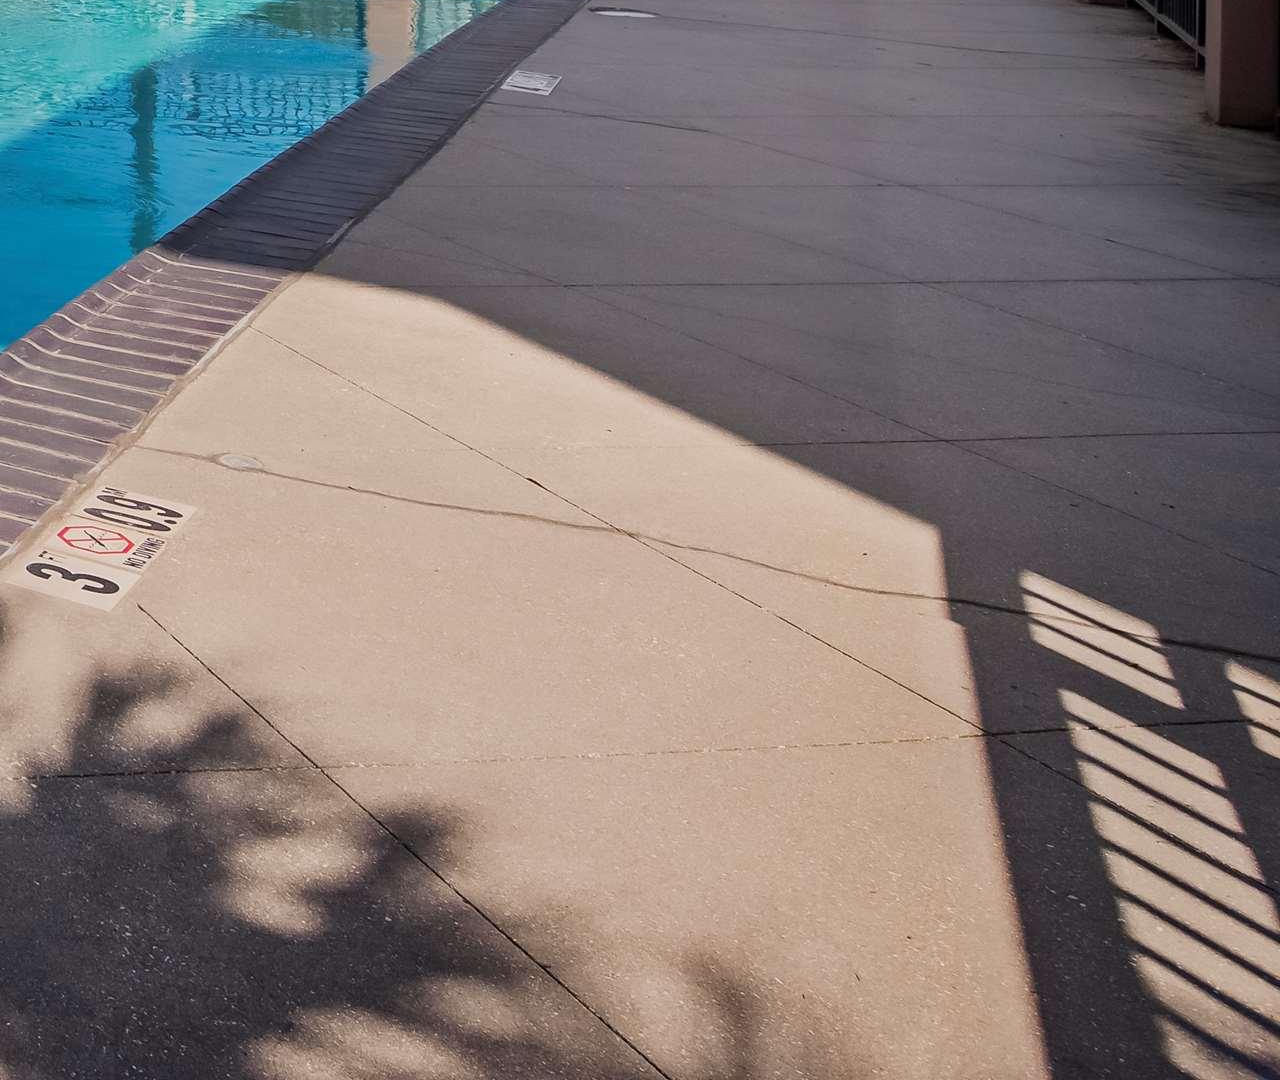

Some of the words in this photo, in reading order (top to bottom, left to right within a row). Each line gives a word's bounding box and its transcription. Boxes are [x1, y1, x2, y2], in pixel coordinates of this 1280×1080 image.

[131, 536, 165, 559] DIVING
[122, 557, 146, 570] NO
[26, 562, 120, 595] 3
